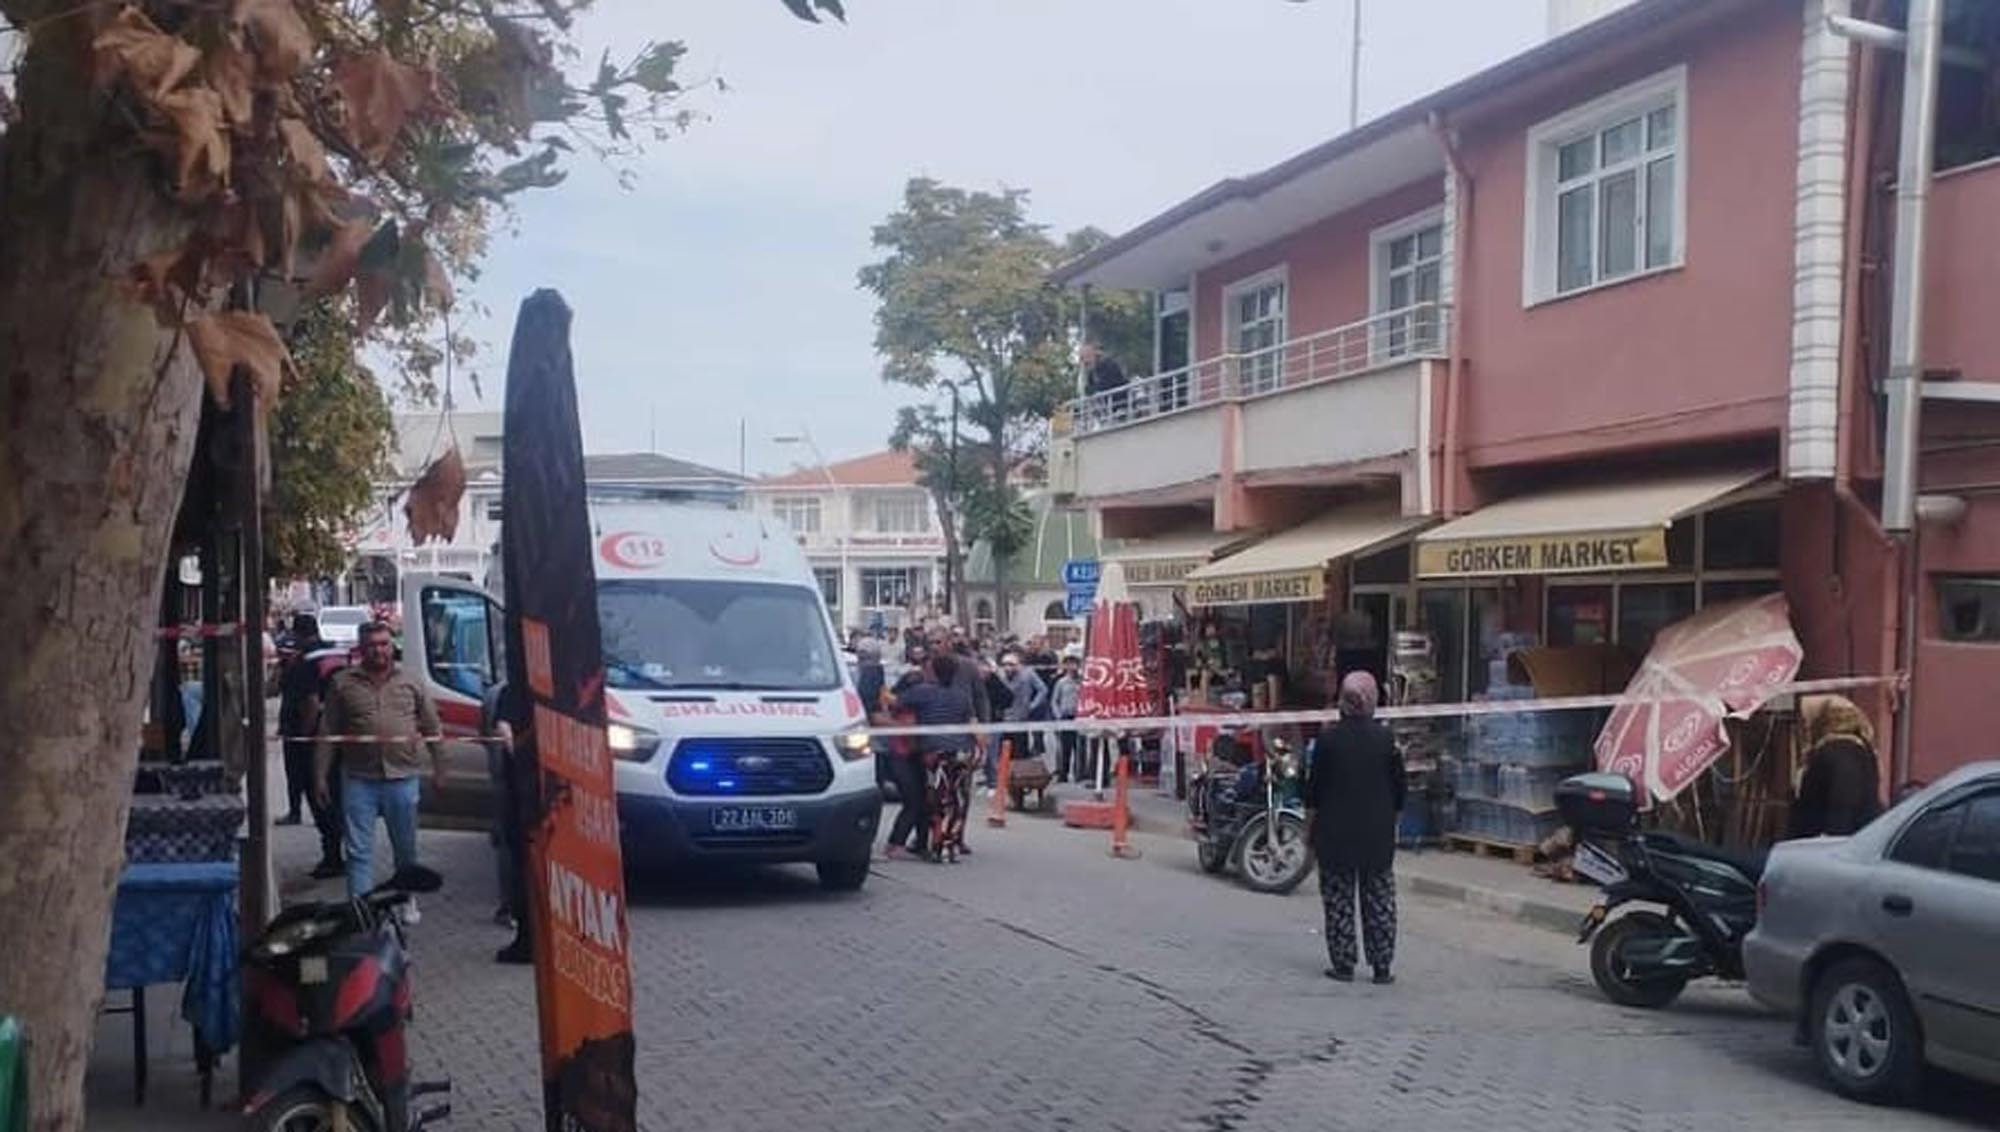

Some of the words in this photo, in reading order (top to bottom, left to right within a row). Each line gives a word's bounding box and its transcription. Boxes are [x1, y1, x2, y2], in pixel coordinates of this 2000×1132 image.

[624, 540, 665, 557] 112
[1541, 538, 1640, 567] MARKET
[1253, 576, 1312, 599] MARKET
